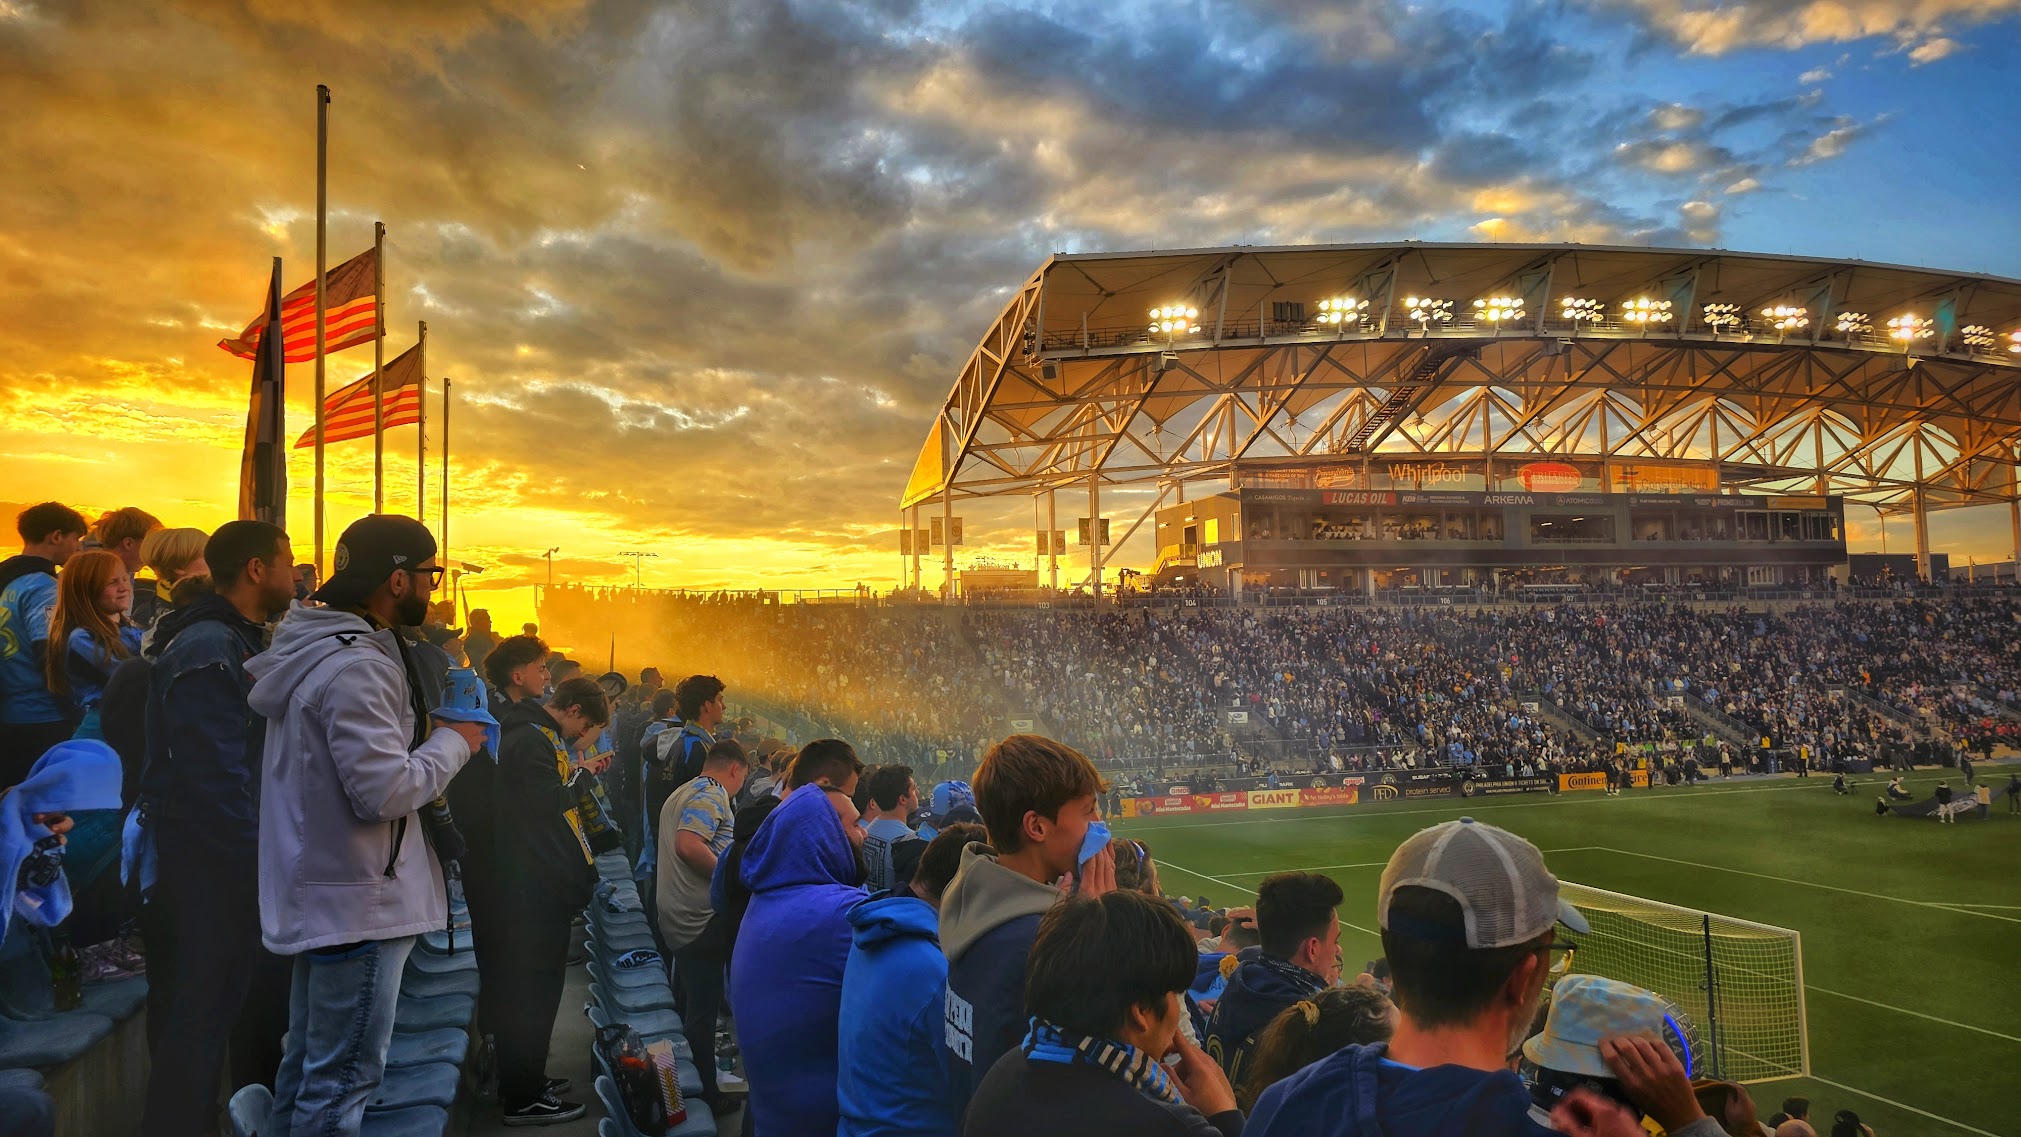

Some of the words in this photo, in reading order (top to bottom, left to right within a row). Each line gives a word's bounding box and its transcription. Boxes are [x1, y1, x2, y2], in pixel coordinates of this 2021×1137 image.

[1388, 462, 1466, 486] Whirlpool
[1641, 478, 1708, 491] Constellation
[1331, 492, 1368, 504] LUCAS
[1370, 493, 1388, 504] OIL
[1484, 495, 1534, 505] ARKEMA
[1196, 549, 1223, 569] UNION
[1038, 601, 1050, 609] 103
[1184, 599, 1197, 607] 104
[1316, 598, 1328, 606] 105
[1440, 597, 1451, 605] 106
[1568, 775, 1607, 788] Continen
[1373, 788, 1392, 800] PFD
[1406, 788, 1429, 797] protein
[1430, 785, 1451, 794] served
[1252, 793, 1294, 804] GIANT
[1318, 793, 1336, 801] today's
